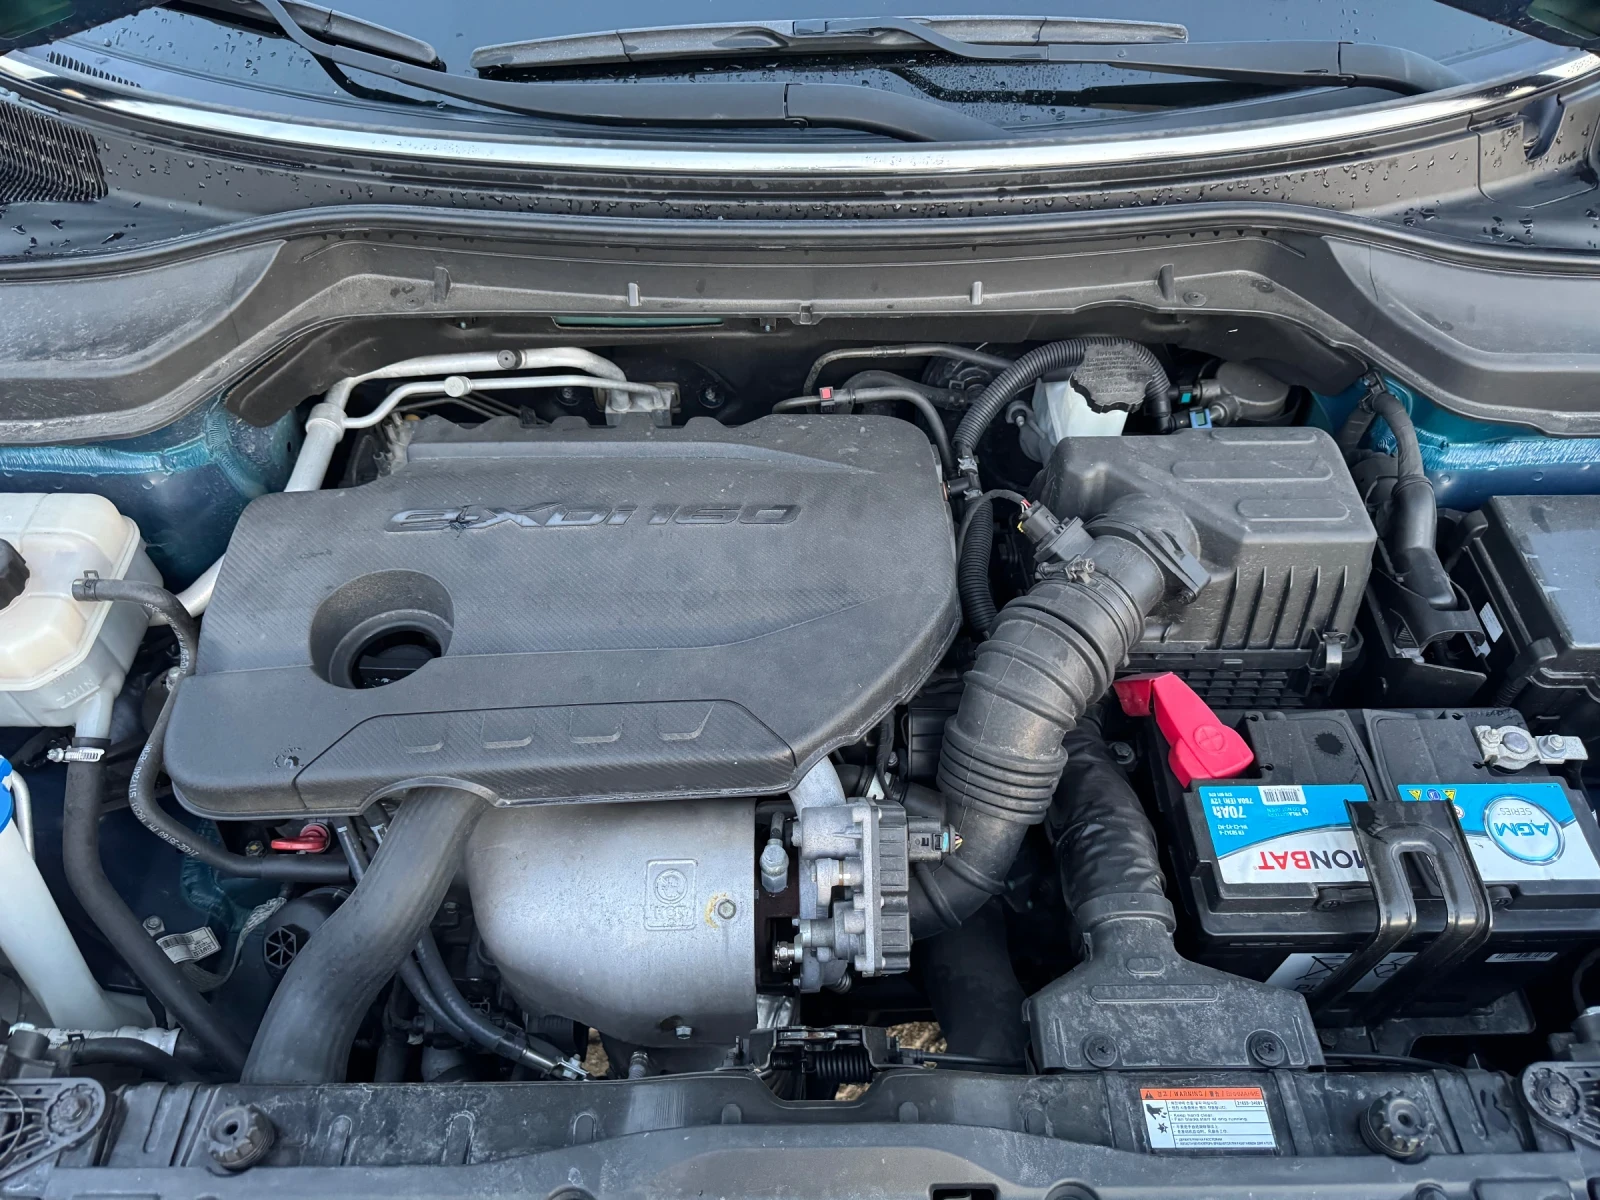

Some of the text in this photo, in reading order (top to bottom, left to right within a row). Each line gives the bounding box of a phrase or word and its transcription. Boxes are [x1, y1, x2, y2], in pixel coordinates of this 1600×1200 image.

[649, 504, 802, 526] 160
[67, 680, 95, 701] MIN
[1212, 805, 1247, 819] 70Ah
[1499, 807, 1533, 816] SERIES
[1493, 822, 1550, 837] AGM
